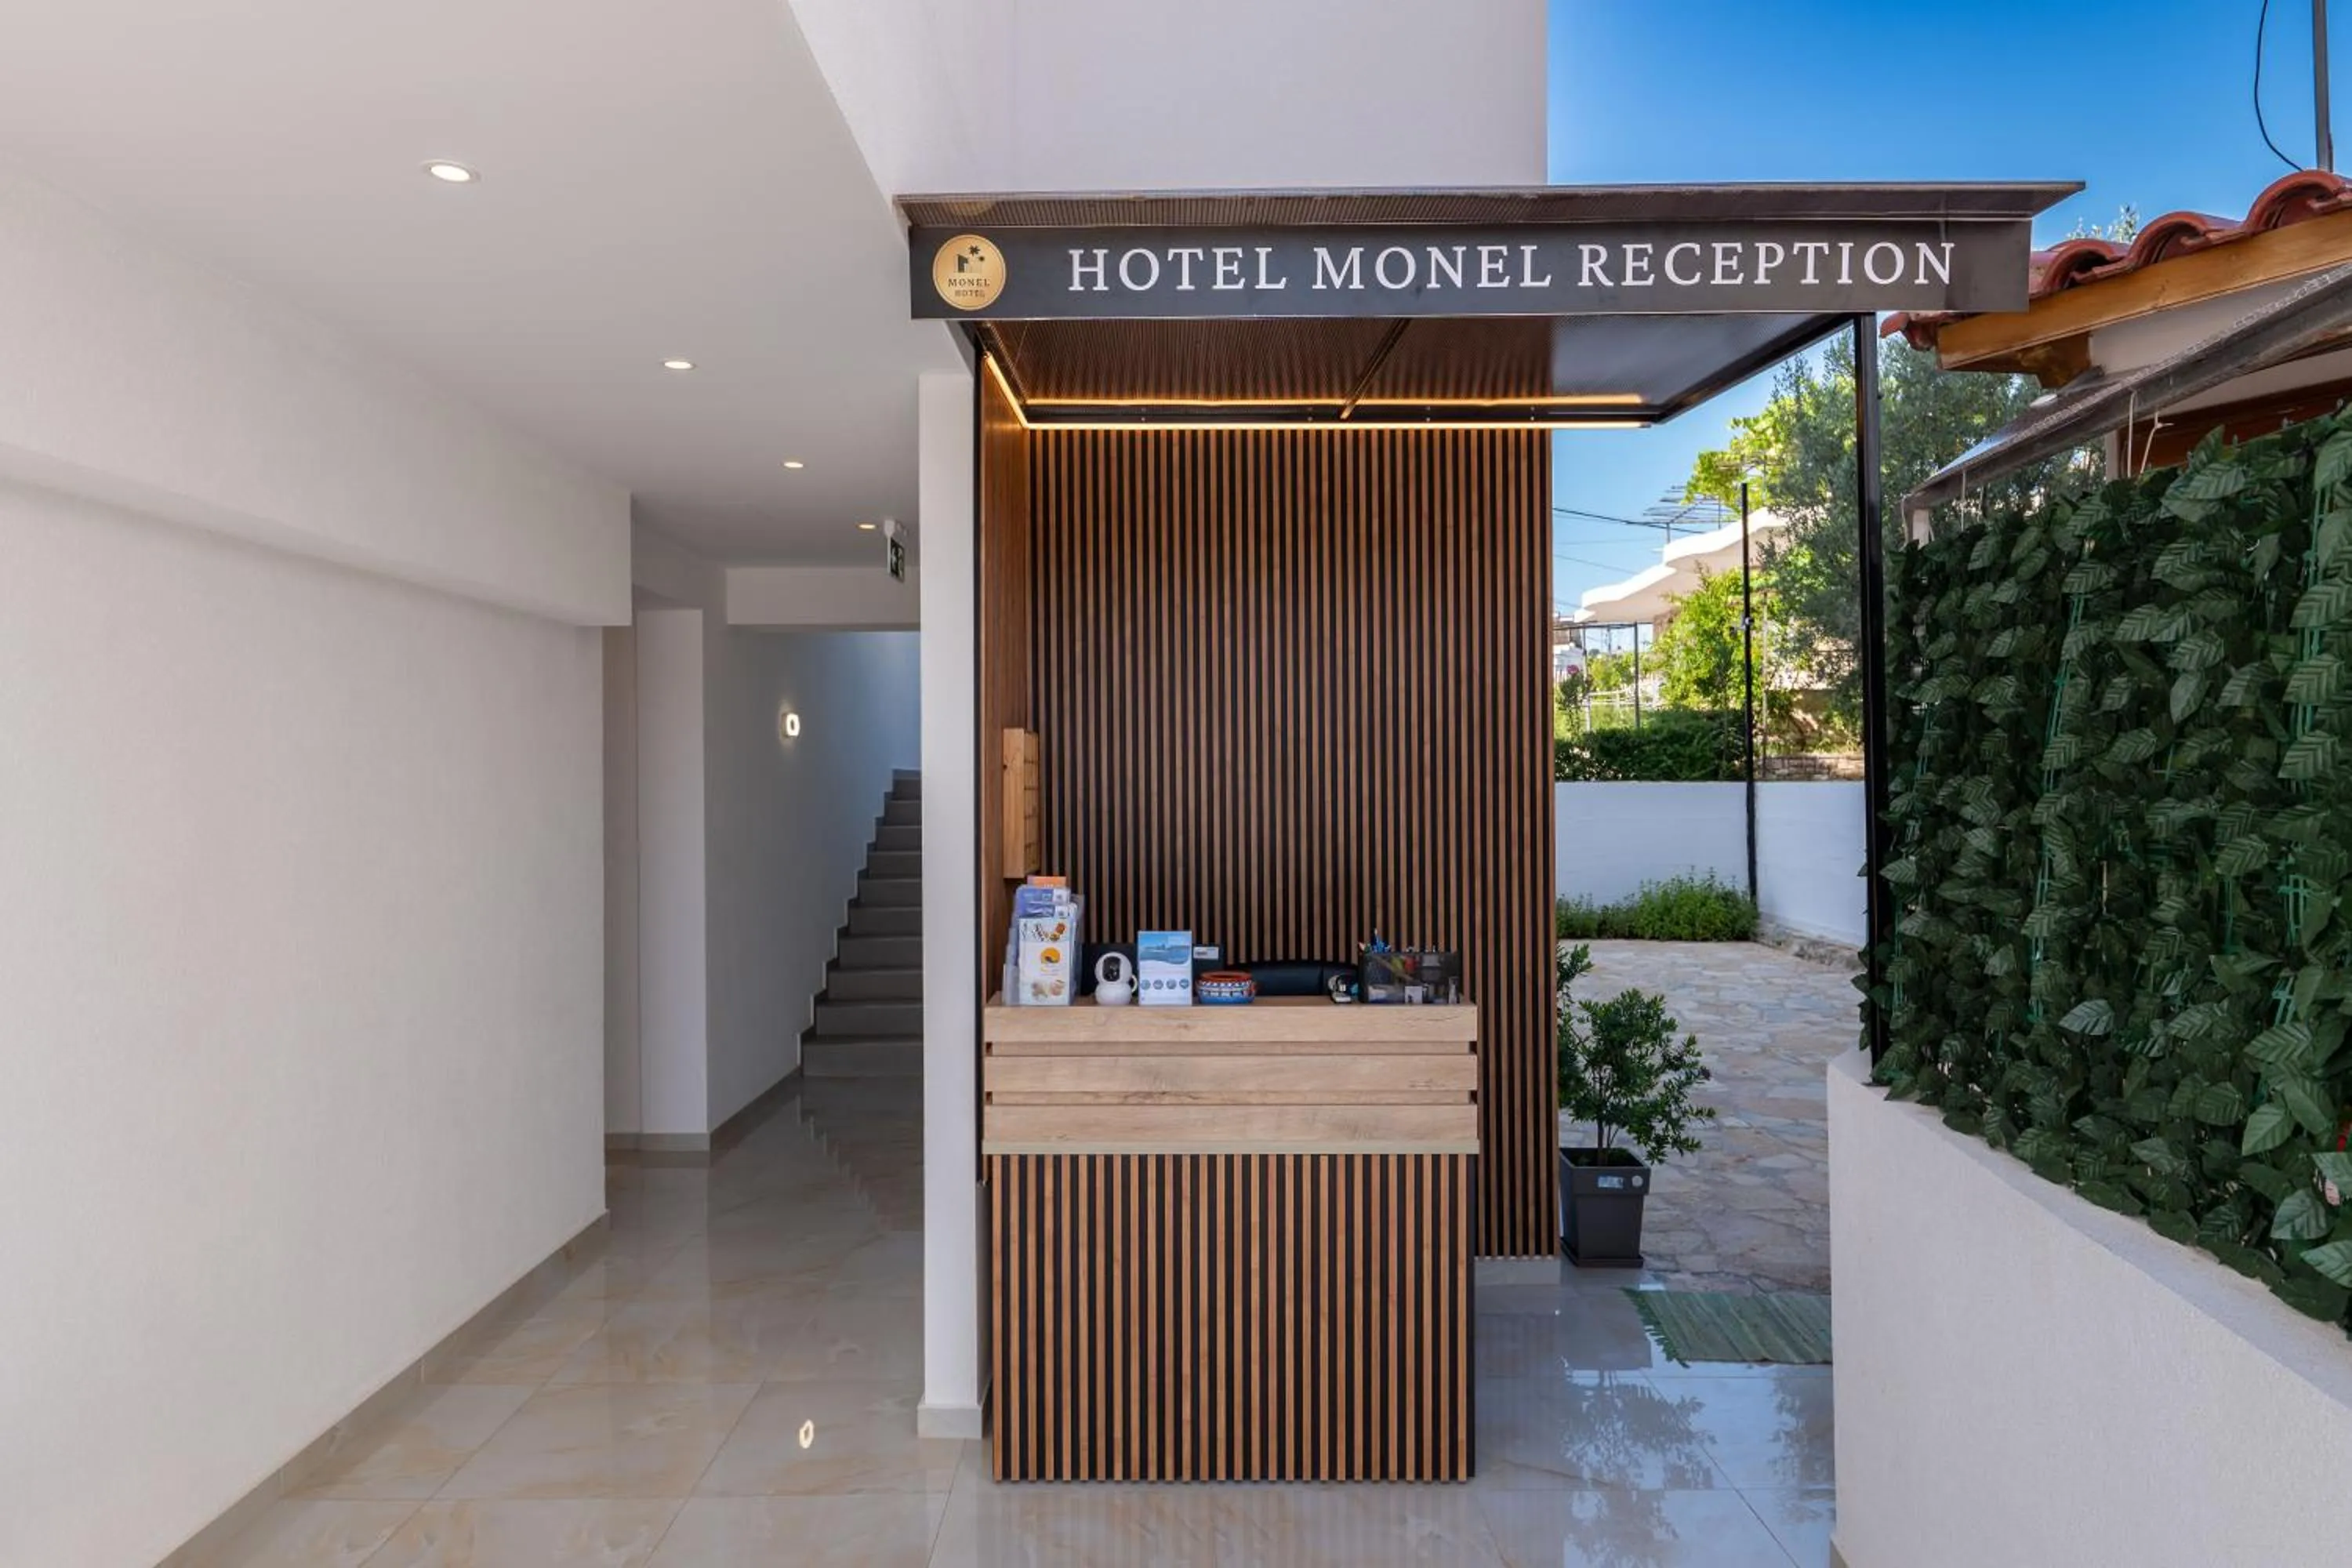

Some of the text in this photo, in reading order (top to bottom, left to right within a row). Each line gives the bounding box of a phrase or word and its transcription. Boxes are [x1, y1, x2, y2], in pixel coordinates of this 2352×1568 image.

[1067, 241, 1955, 291] HOTEL MONEL RECEPTION
[948, 278, 990, 287] MONEL
